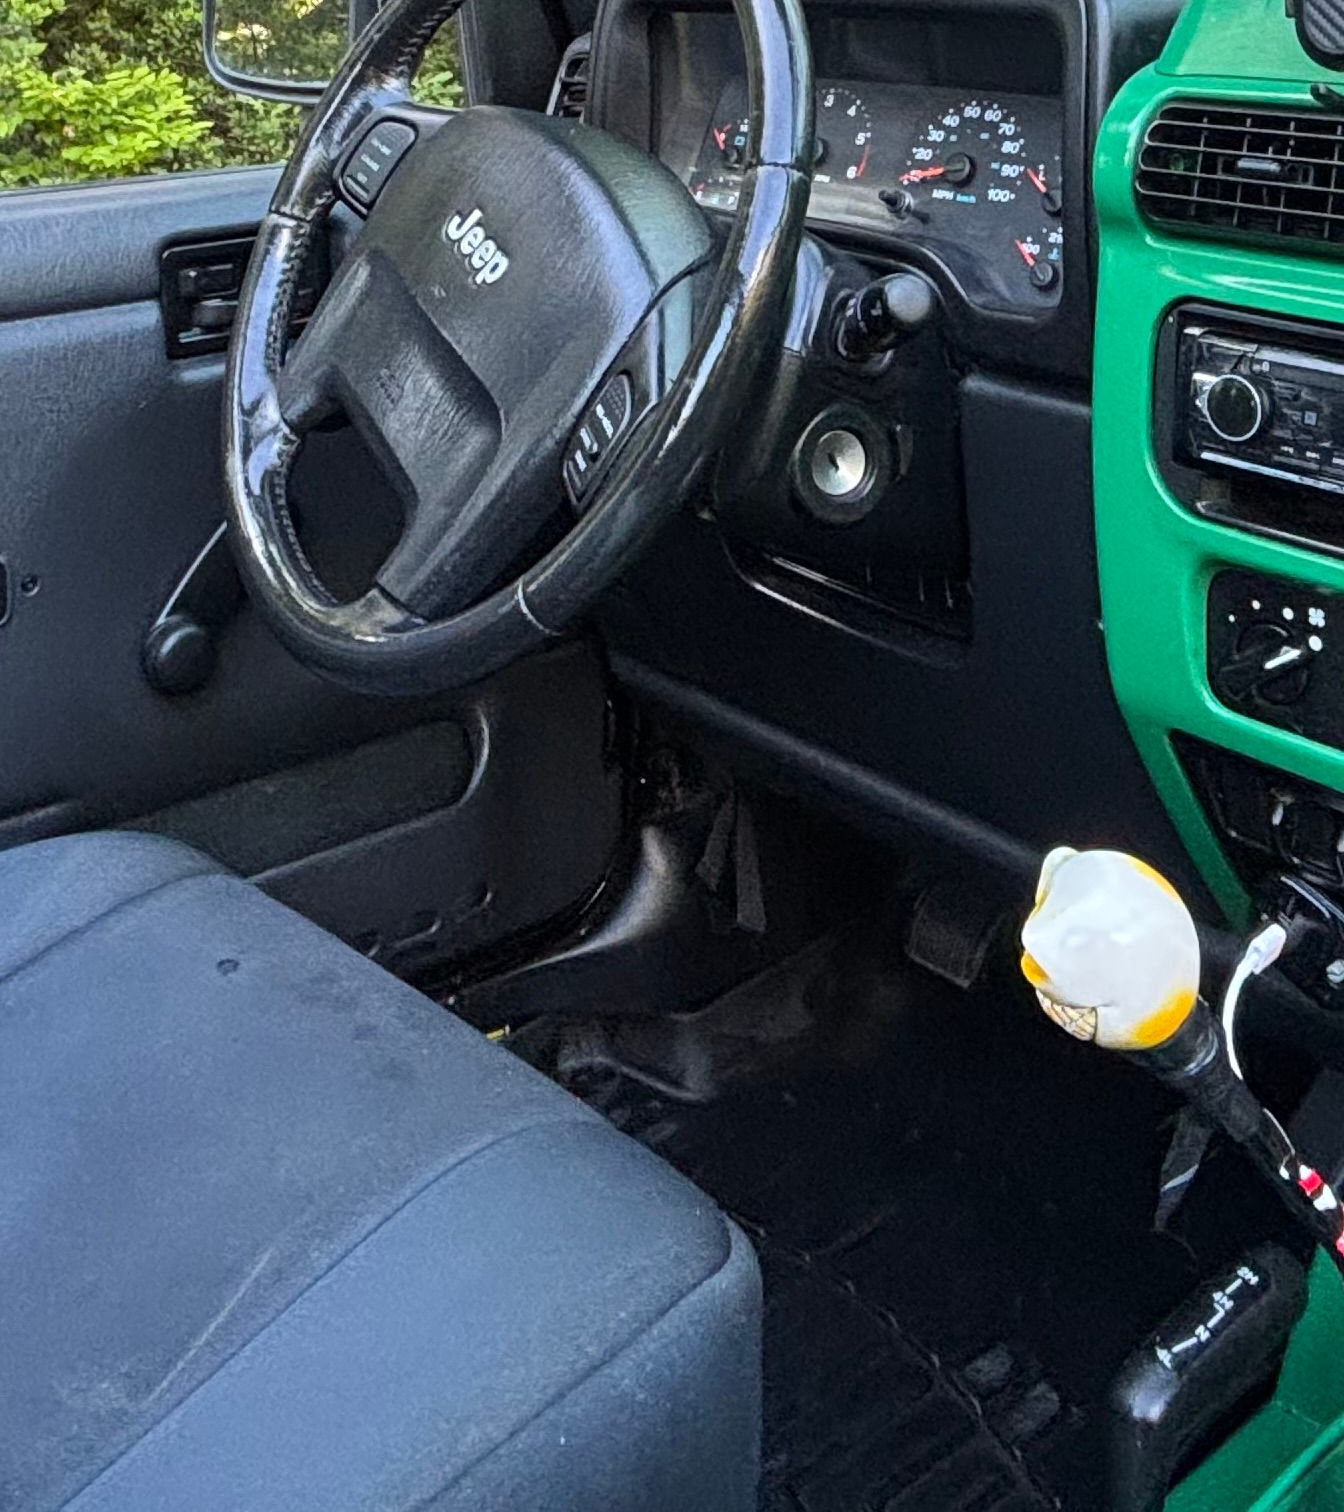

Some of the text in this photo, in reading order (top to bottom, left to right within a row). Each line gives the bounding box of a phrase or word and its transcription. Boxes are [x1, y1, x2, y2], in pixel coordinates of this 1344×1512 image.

[824, 94, 834, 107] 3
[847, 104, 857, 117] 4
[984, 109, 1002, 122] 60
[942, 114, 960, 127] 40
[997, 122, 1015, 136] 70
[855, 132, 866, 145] 5
[927, 130, 945, 142] 30
[1001, 141, 1020, 154] 80
[1000, 164, 1020, 178] 90
[931, 189, 954, 201] MPH
[987, 189, 1010, 203] 100
[446, 209, 510, 285] Jeep
[1194, 1324, 1212, 1343] N
